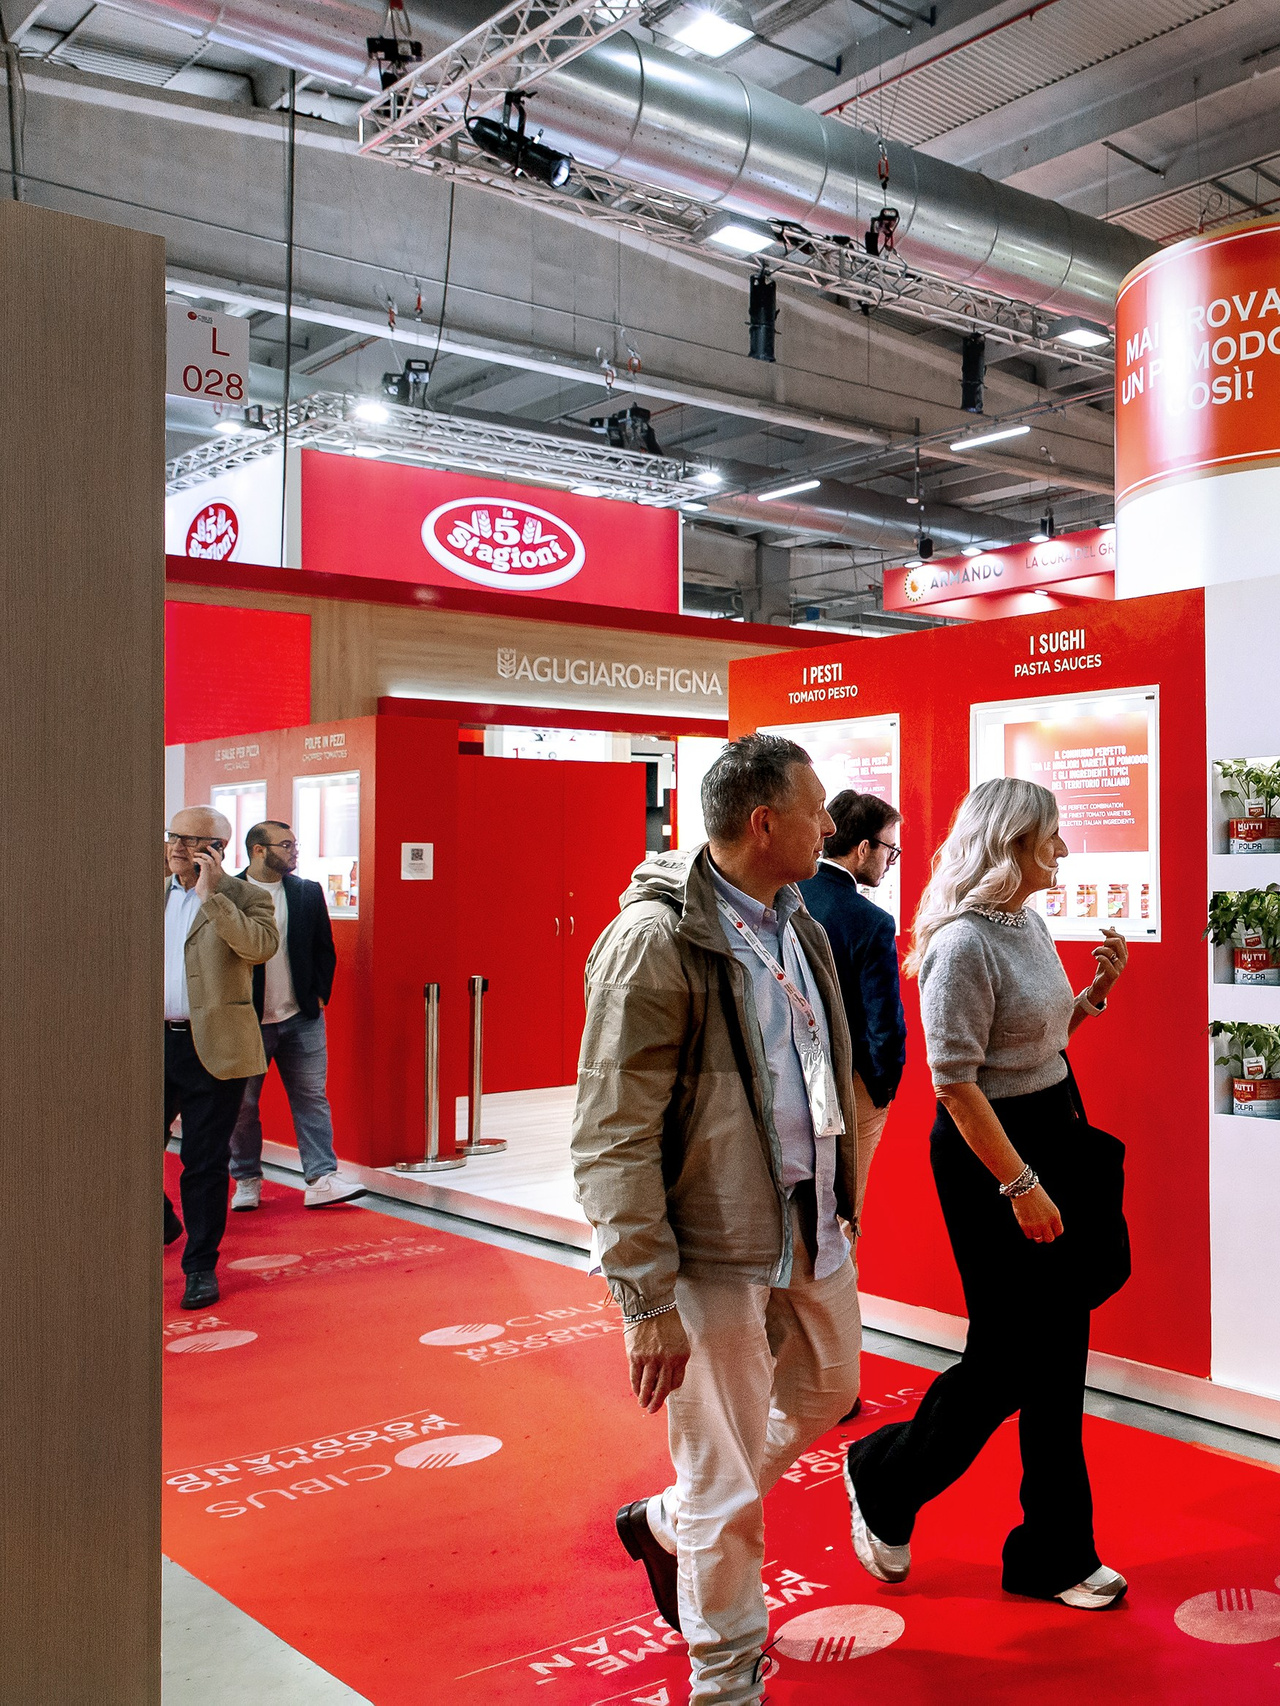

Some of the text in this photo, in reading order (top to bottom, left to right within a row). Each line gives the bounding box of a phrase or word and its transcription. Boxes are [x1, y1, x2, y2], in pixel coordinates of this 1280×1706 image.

[211, 326, 230, 357] L
[1125, 321, 1160, 367] MAI
[182, 364, 244, 401] 028
[1121, 365, 1145, 406] UN
[492, 517, 522, 546] 5
[1025, 555, 1040, 569] LA
[1073, 547, 1096, 561] DEL
[930, 559, 1005, 590] ARMANDO
[1029, 629, 1085, 656] I SUGHI
[802, 662, 843, 685] I PESTI
[1014, 653, 1102, 677] PASTA SAUCES
[788, 684, 859, 704] TOMATO PESTO
[304, 733, 346, 750] POLPE IN PEZZI
[1094, 745, 1127, 757] PERFETTO
[1069, 767, 1108, 779] INGREDIENTI
[1109, 766, 1129, 777] TIPICI
[1080, 756, 1107, 768] VARIETÀ
[1064, 778, 1100, 790] TERRITORIO
[1101, 776, 1130, 787] ITALIANO
[1237, 822, 1263, 832] MUTTI
[1238, 842, 1263, 850] POLPA
[1241, 953, 1267, 961] MUTTI
[1242, 973, 1266, 981] POLPA
[453, 1318, 616, 1357] WELCOME
[467, 1325, 624, 1362] FOODLA
[165, 1413, 446, 1487] FOODLAND
[176, 1419, 460, 1494] WELCOME TO
[204, 1463, 393, 1519] CIBUS
